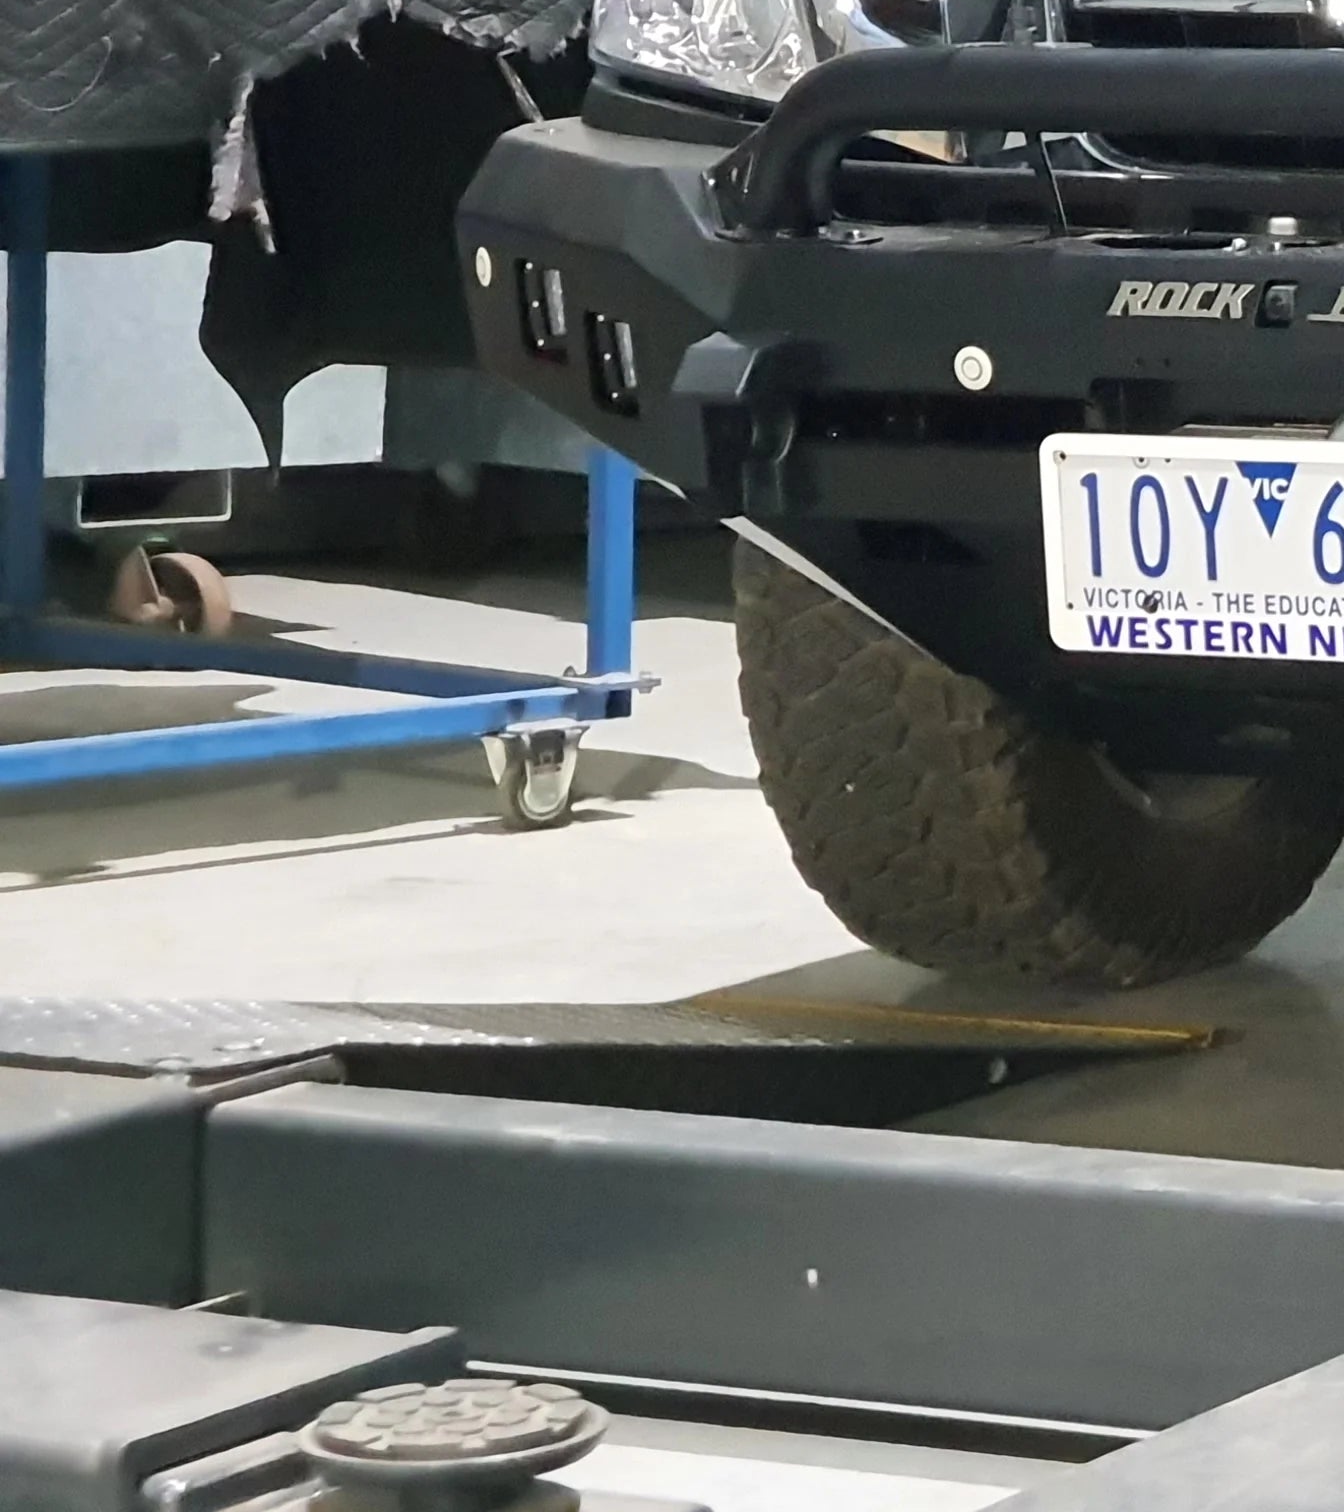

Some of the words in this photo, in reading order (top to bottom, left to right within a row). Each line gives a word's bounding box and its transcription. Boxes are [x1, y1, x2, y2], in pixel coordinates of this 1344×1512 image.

[1106, 280, 1255, 319] ROCK
[1247, 477, 1289, 501] VIC
[1083, 587, 1188, 611] VICTORIA
[1212, 592, 1255, 614] THE
[1086, 614, 1288, 655] WESTERN
